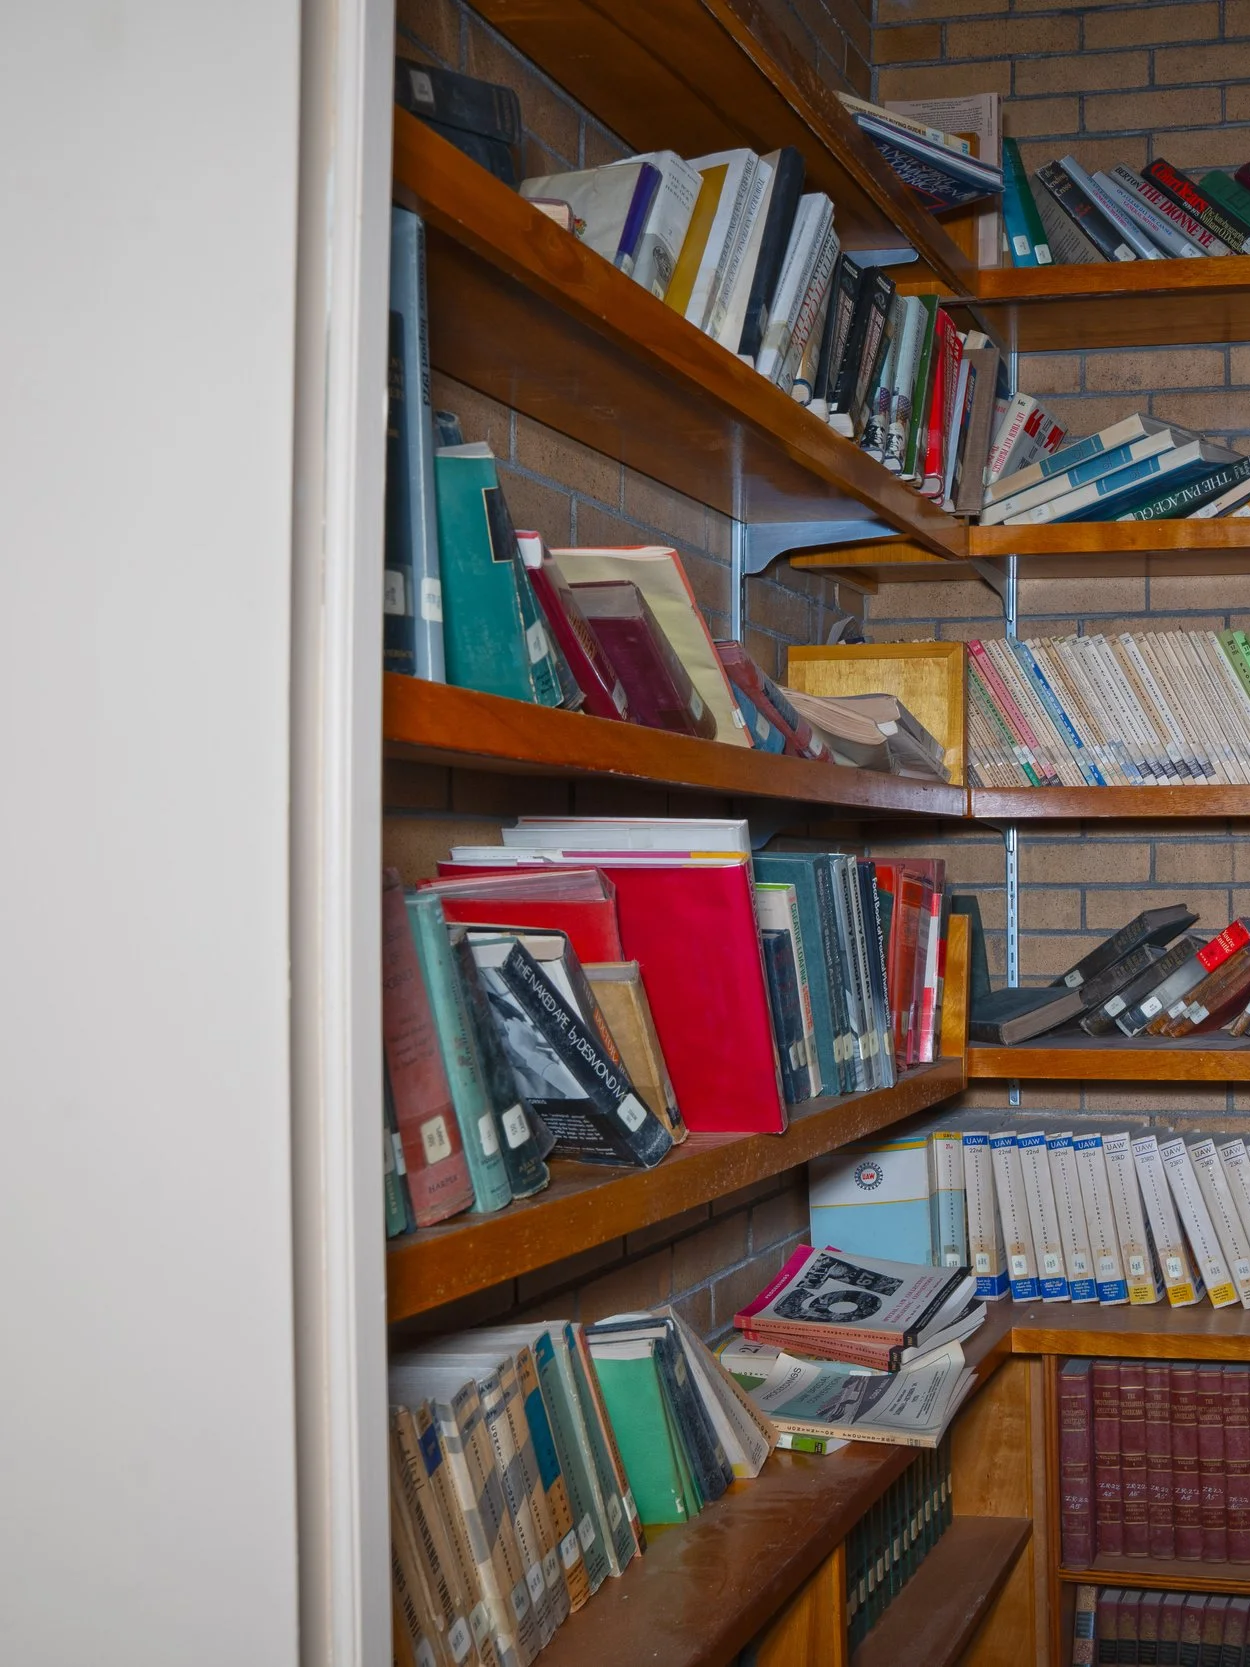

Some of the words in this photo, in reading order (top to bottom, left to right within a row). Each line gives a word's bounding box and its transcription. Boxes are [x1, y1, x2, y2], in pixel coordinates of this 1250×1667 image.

[1114, 165, 1141, 189] BERTON
[1136, 180, 1164, 206] THE
[1157, 198, 1201, 237] DIONNE
[1200, 469, 1232, 493] THE
[1151, 482, 1202, 517] PALACE
[870, 877, 879, 901] Focal
[873, 902, 882, 926] Book
[875, 926, 883, 935] of
[1222, 929, 1235, 948] You're
[875, 935, 887, 972] Practical
[878, 972, 893, 1027] Photography
[512, 954, 534, 979] THE
[525, 973, 558, 1013] NAKED
[551, 1007, 572, 1030] APE
[563, 1025, 584, 1045] by
[574, 1036, 619, 1091] DESMOND
[966, 1137, 984, 1145] UAW
[994, 1138, 1012, 1146] UAW
[1022, 1137, 1040, 1145] UAW
[1050, 1140, 1068, 1148] UAW
[1078, 1140, 1096, 1148] UAW
[1141, 1155, 1155, 1163] 23RD
[1170, 1159, 1183, 1167] 23RD
[1201, 1159, 1214, 1168] 23RD
[428, 1173, 458, 1194] HARPER
[765, 1273, 790, 1299] PROCEEDINGS
[856, 1272, 875, 1287] 67
[763, 1368, 802, 1400] PROCEEDINGS
